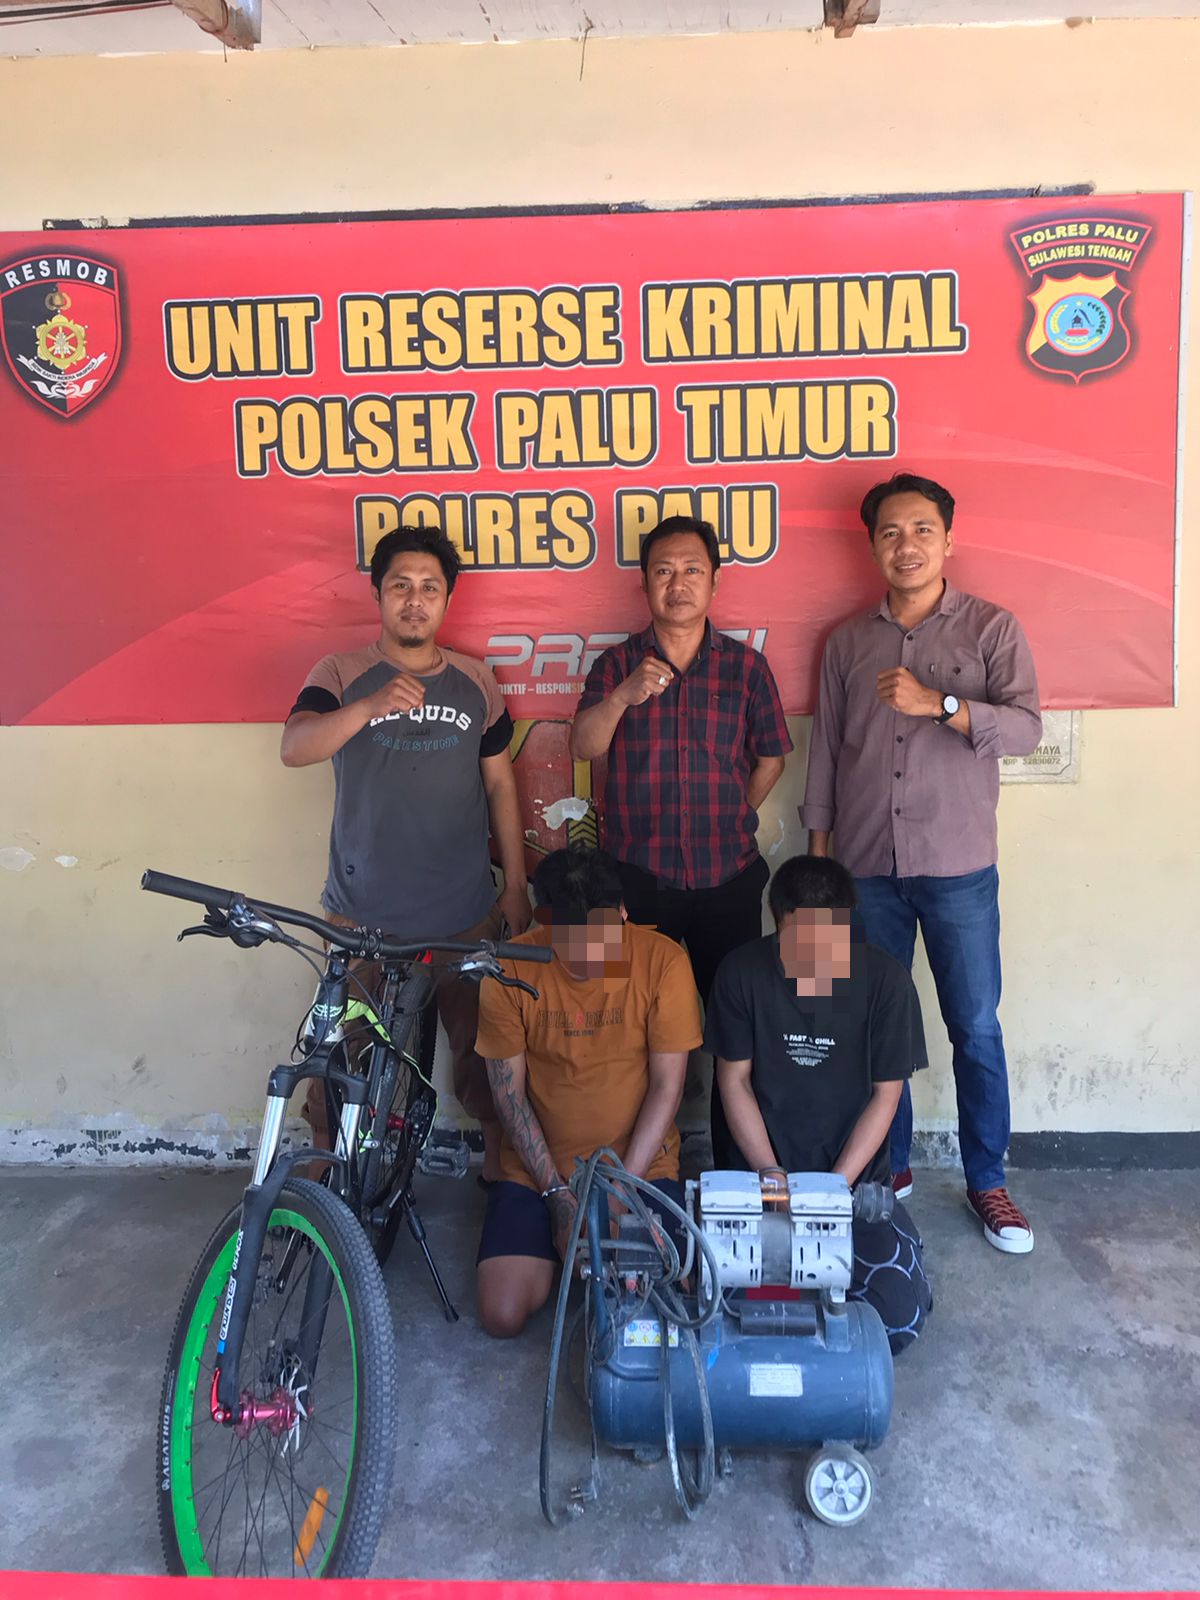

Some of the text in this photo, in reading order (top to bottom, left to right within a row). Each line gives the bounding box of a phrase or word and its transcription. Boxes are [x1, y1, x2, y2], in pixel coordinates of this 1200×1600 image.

[1021, 223, 1139, 248] POLRES PALU
[1028, 245, 1132, 267] SULAWESI TENGAH
[5, 259, 108, 288] RESMOB
[164, 271, 966, 380] UNIT RESERSE KRIMINAL
[235, 378, 898, 477] POLSEK PALU TIMUR
[616, 483, 778, 568] PLU
[815, 1038, 836, 1046] CHILL
[162, 1405, 171, 1477] AGATHOS
